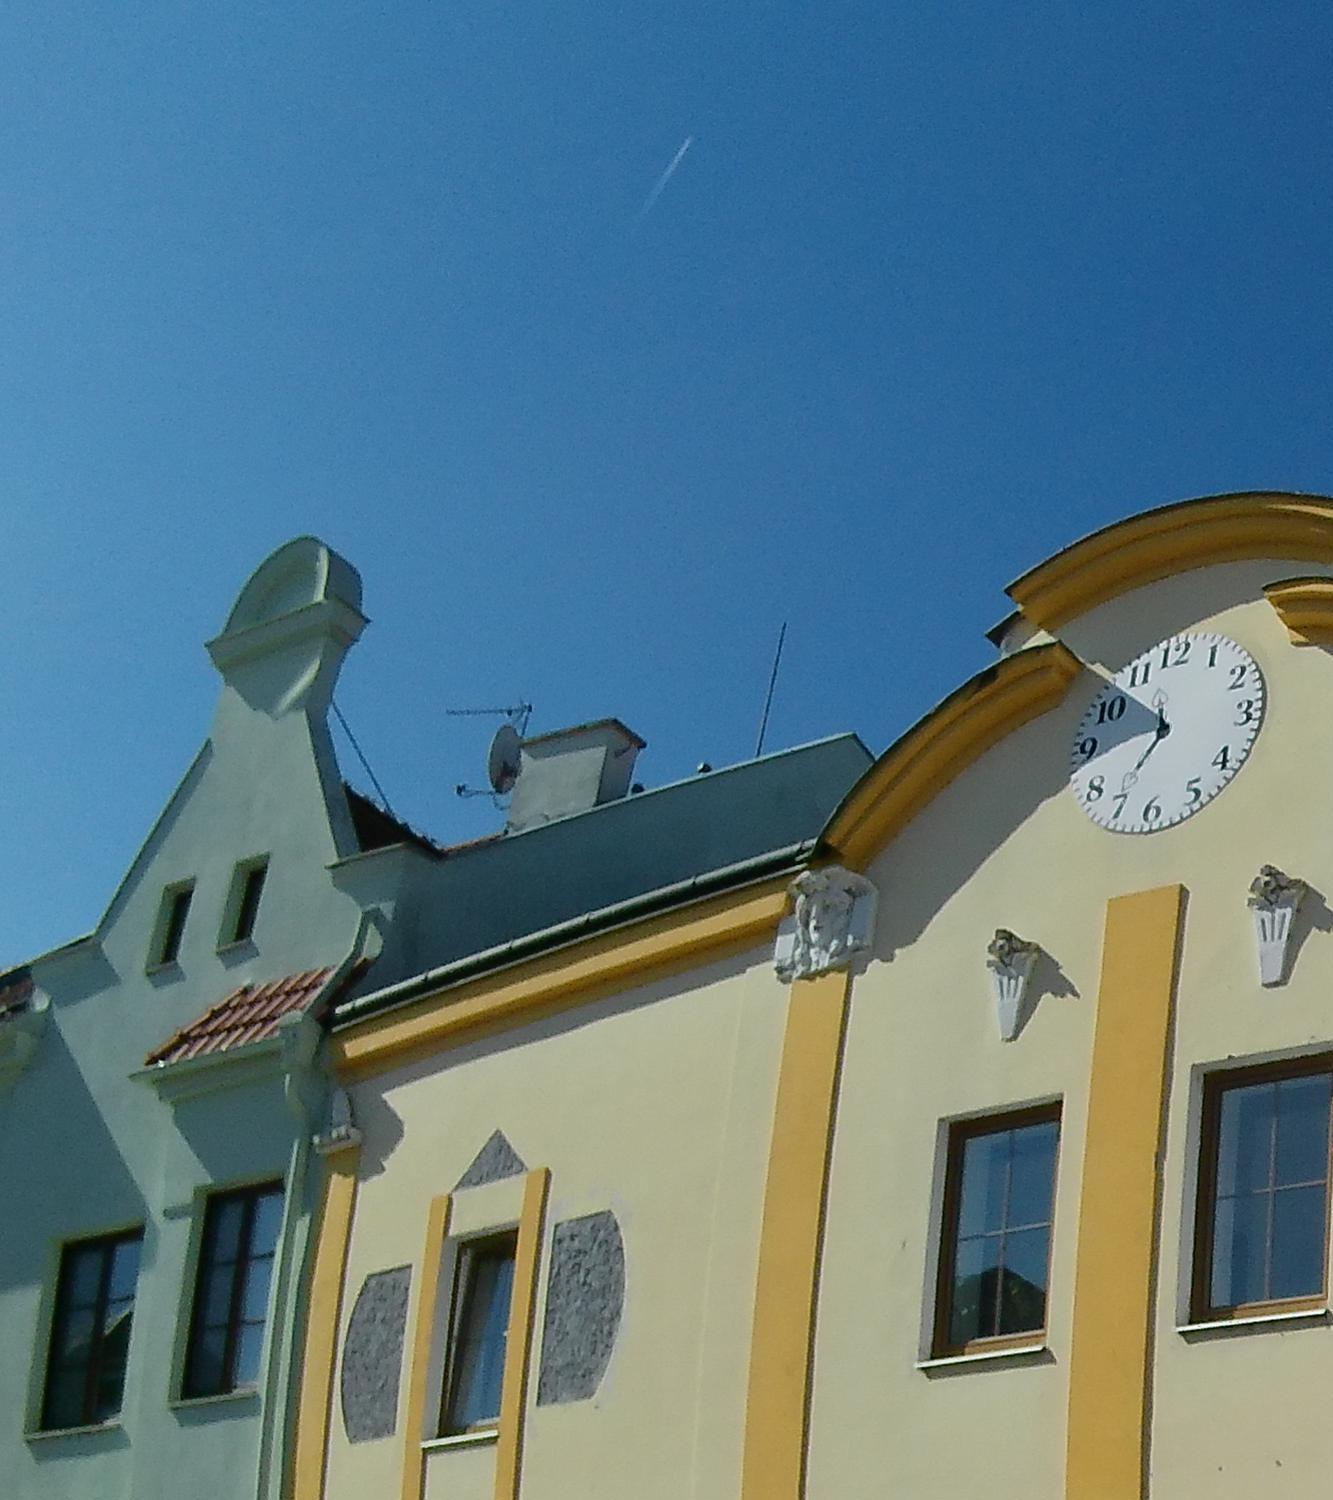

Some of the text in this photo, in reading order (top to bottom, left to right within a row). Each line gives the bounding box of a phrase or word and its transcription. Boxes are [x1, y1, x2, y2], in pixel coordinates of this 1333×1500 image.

[1160, 641, 1192, 669] 12
[1209, 644, 1220, 668] 1
[1129, 661, 1152, 687] 11
[1229, 665, 1247, 691] 2
[1096, 695, 1127, 725] 10
[1236, 700, 1254, 726] 3
[1079, 737, 1098, 761] 9
[1212, 745, 1230, 771] 4
[1086, 775, 1105, 803] 8
[1184, 777, 1202, 806] 5
[1112, 793, 1128, 819] 7
[1142, 795, 1162, 824] 6
